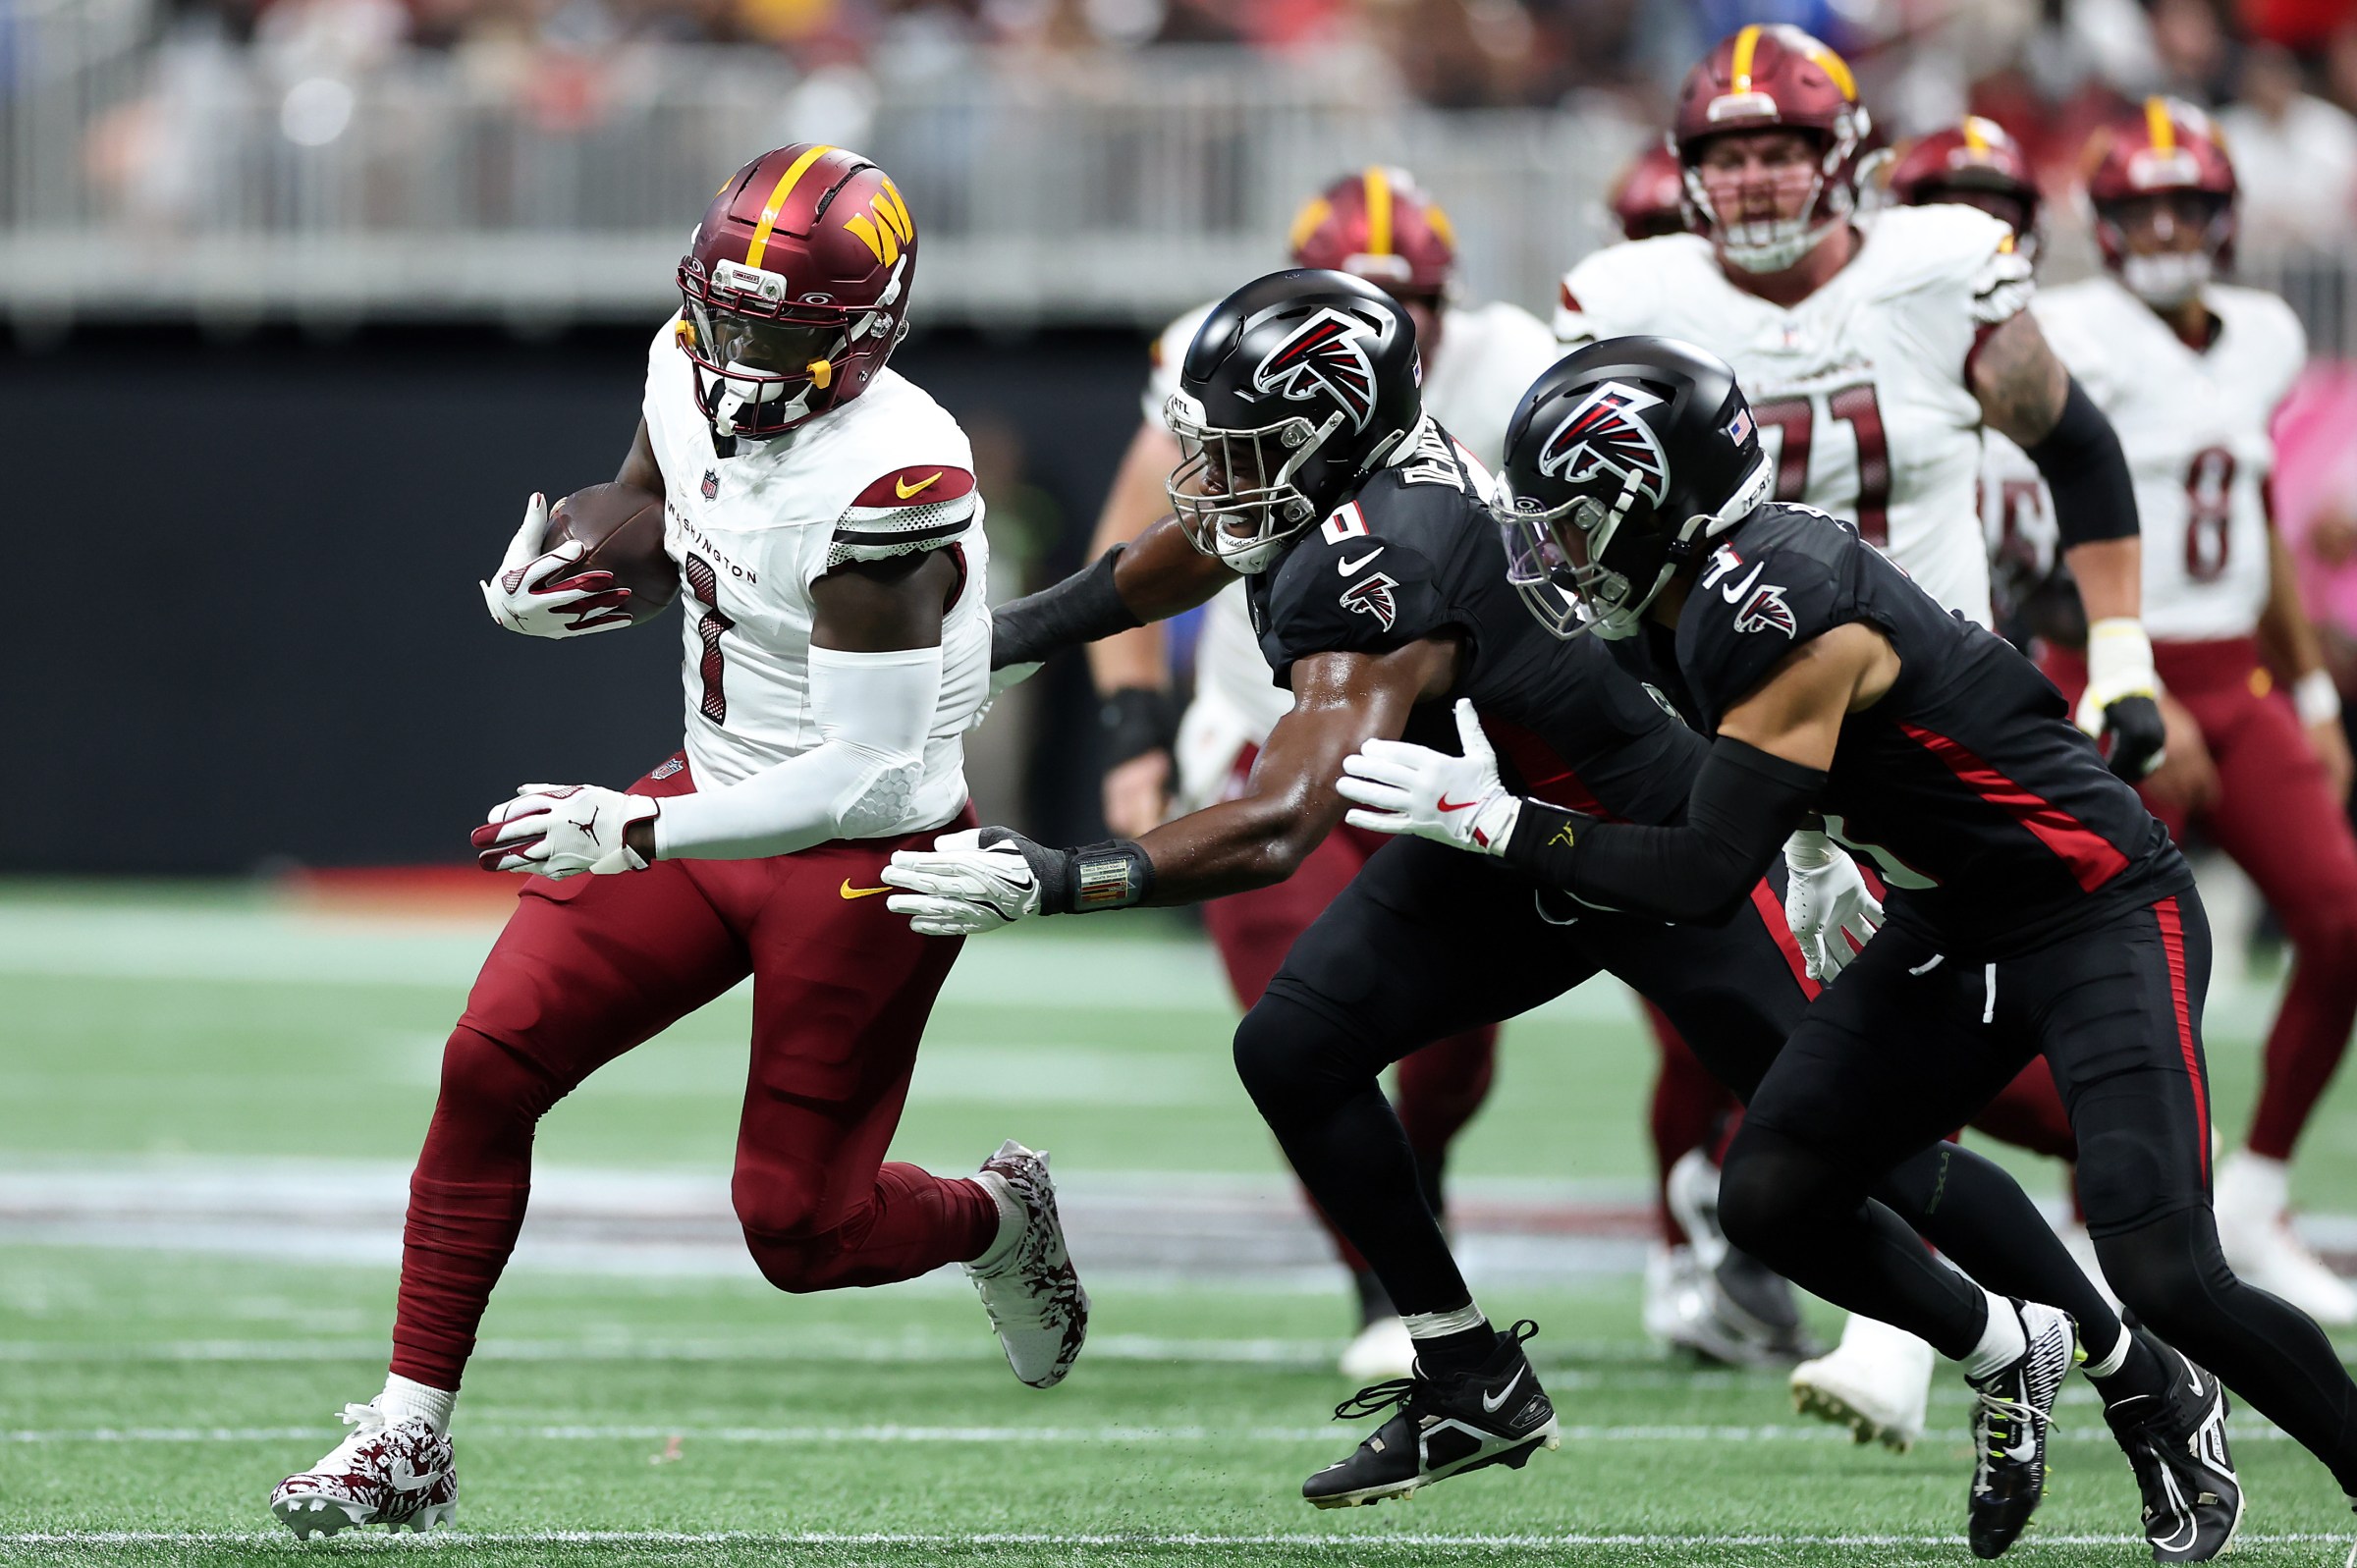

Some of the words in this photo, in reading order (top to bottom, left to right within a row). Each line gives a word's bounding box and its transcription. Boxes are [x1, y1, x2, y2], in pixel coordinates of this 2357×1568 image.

[1751, 382, 1891, 549] 71
[2185, 448, 2236, 584] 8
[667, 499, 757, 584] WASHINGTON
[685, 551, 737, 727] 1
